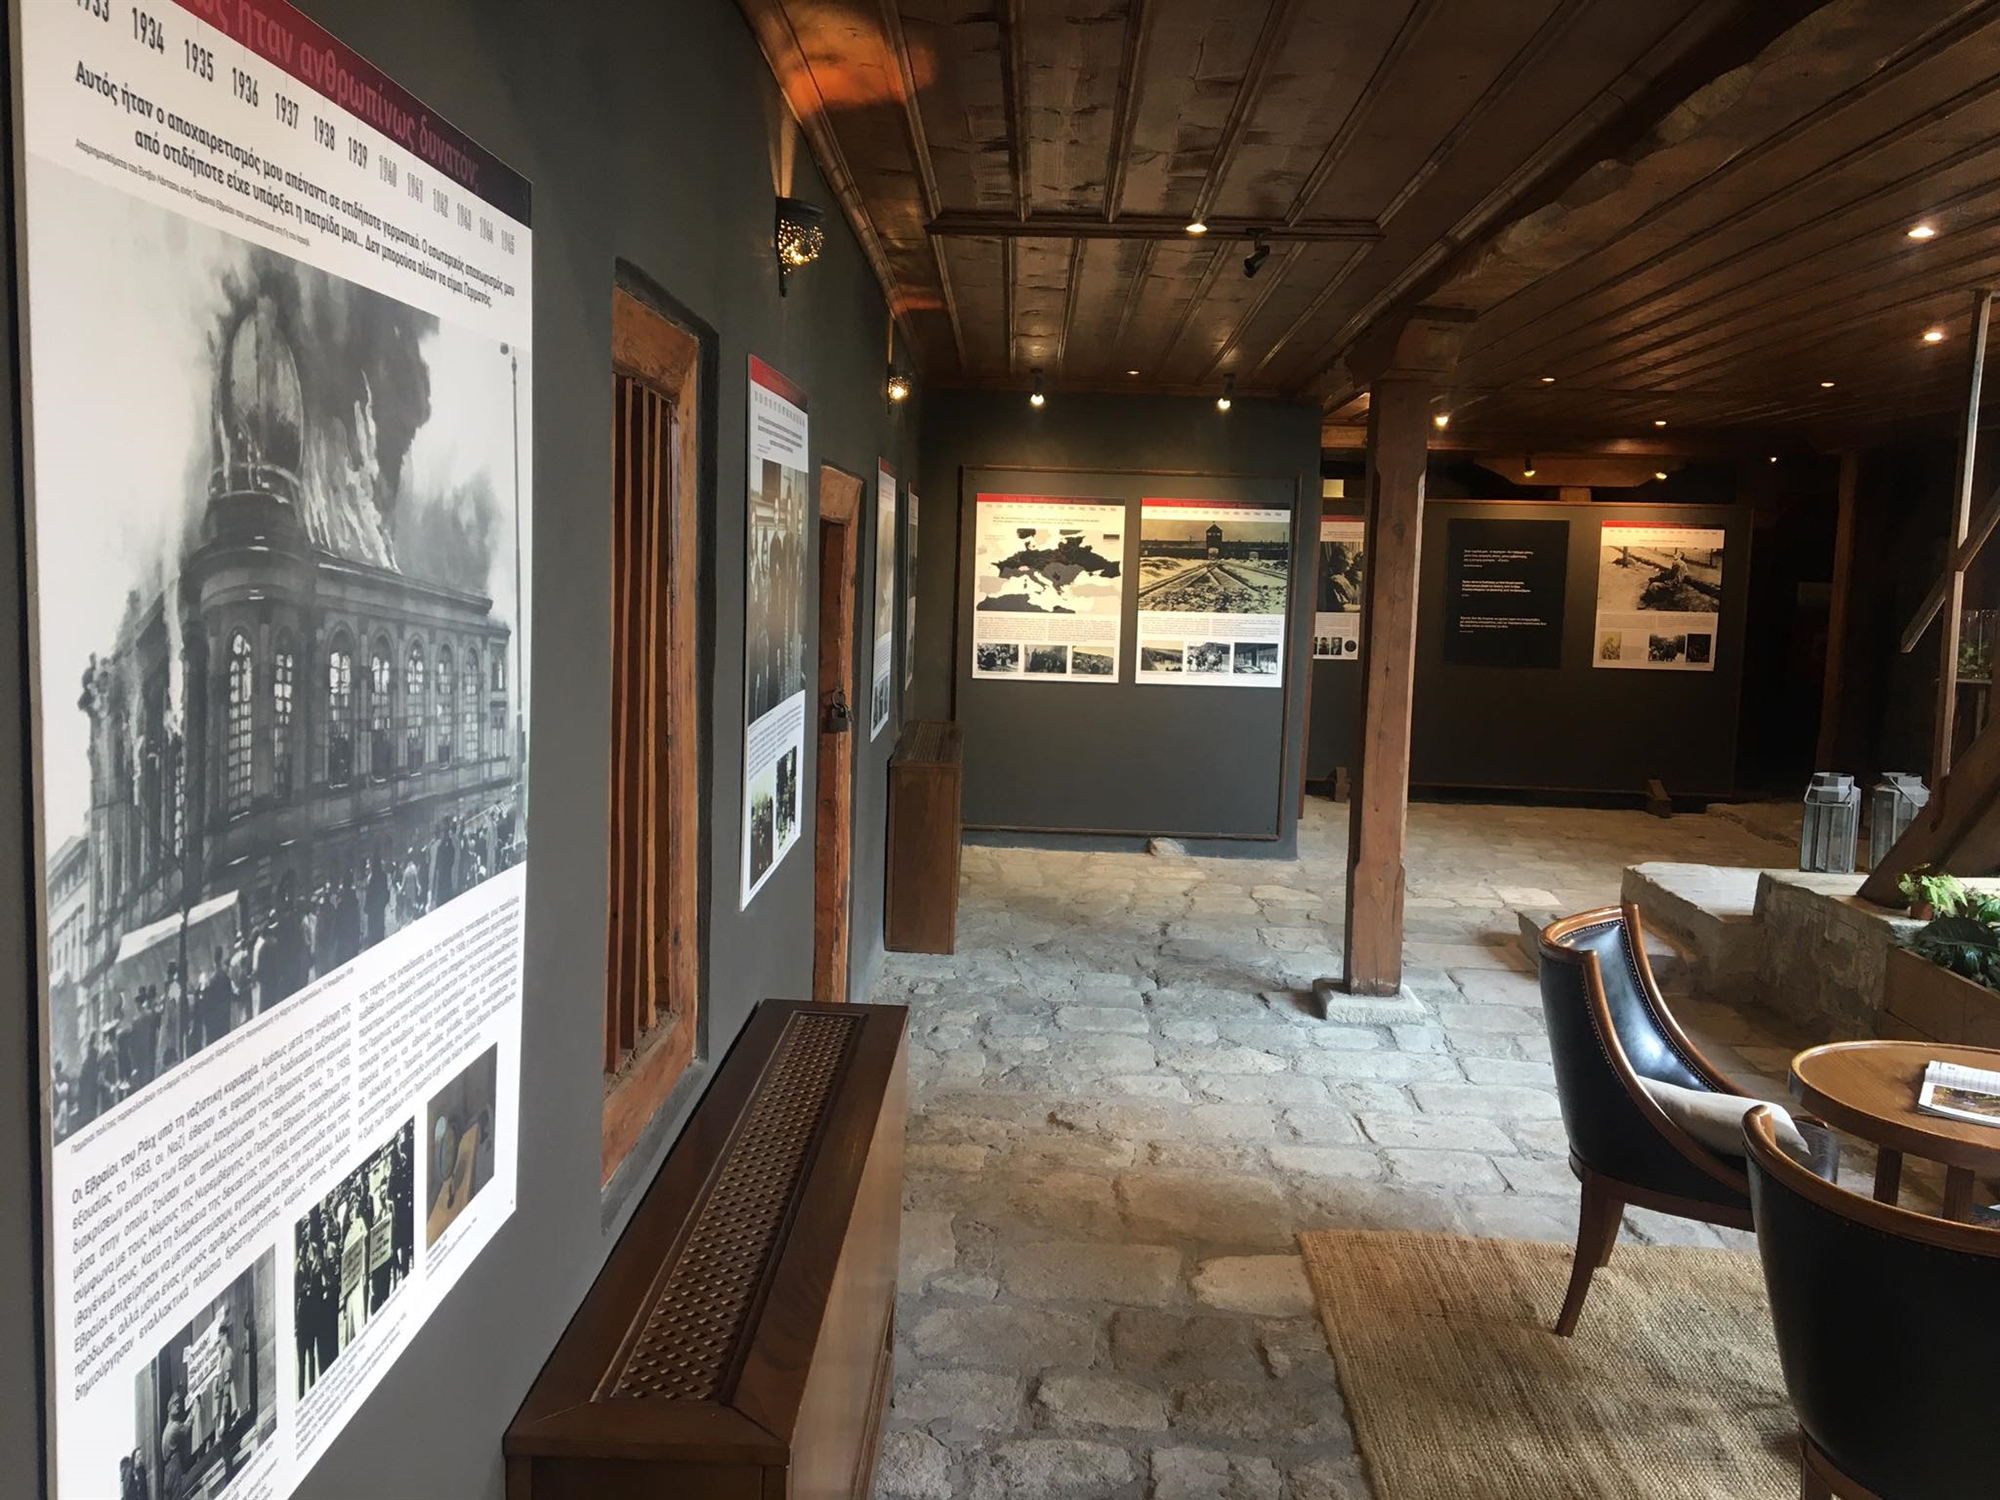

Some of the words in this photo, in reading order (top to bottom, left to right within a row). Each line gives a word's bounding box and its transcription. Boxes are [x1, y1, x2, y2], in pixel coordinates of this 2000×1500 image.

[131, 8, 164, 53] 1934
[183, 39, 214, 81] 1935
[231, 67, 258, 106] 1936
[274, 92, 298, 128] 1937
[312, 115, 335, 150] 1938
[347, 136, 367, 168] 1939
[75, 61, 117, 105] Αυτός
[121, 83, 152, 117] ήταν
[156, 107, 164, 124] ο
[167, 114, 260, 173] αποχαιρετισμός
[262, 160, 282, 181] μου
[284, 172, 327, 203] απέναντι
[328, 194, 340, 210] σε
[341, 201, 381, 230] οτιδήποτε
[134, 130, 160, 154] από
[162, 144, 224, 183] οτιδήποτε
[226, 169, 250, 195] είχε
[252, 184, 293, 215] υπάρξει
[295, 204, 302, 223] η
[303, 209, 339, 236] πατρίδα
[341, 225, 363, 247] μου...
[365, 234, 380, 254] Δεν
[72, 1188, 82, 1204] Οι
[84, 1163, 118, 1194] Εβραίοι
[121, 1149, 136, 1167] του
[137, 1134, 156, 1155] Ράιχ
[72, 1191, 112, 1229] εξουσίας
[116, 1179, 126, 1194] το
[72, 1207, 123, 1253] διακρίσεων
[124, 1178, 159, 1212] εναντίον
[73, 1253, 95, 1282] μέσα
[99, 1232, 120, 1256] στην
[123, 1209, 148, 1236] οποία
[73, 1261, 114, 1303] σύμφωνα
[114, 1251, 126, 1271] με
[127, 1233, 147, 1255] τους
[148, 1207, 178, 1238] Νόμους
[73, 1315, 107, 1352] Εβραίοι
[109, 1269, 159, 1319] επιχείρησαν
[74, 1282, 116, 1327] ιθαγένειά
[140, 1241, 161, 1268] Κατά
[118, 1307, 139, 1335] αλλά
[139, 1290, 160, 1317] μόνο
[74, 1338, 133, 1400] δημιούργησαν
[138, 1284, 189, 1338] εναλλακτικά
